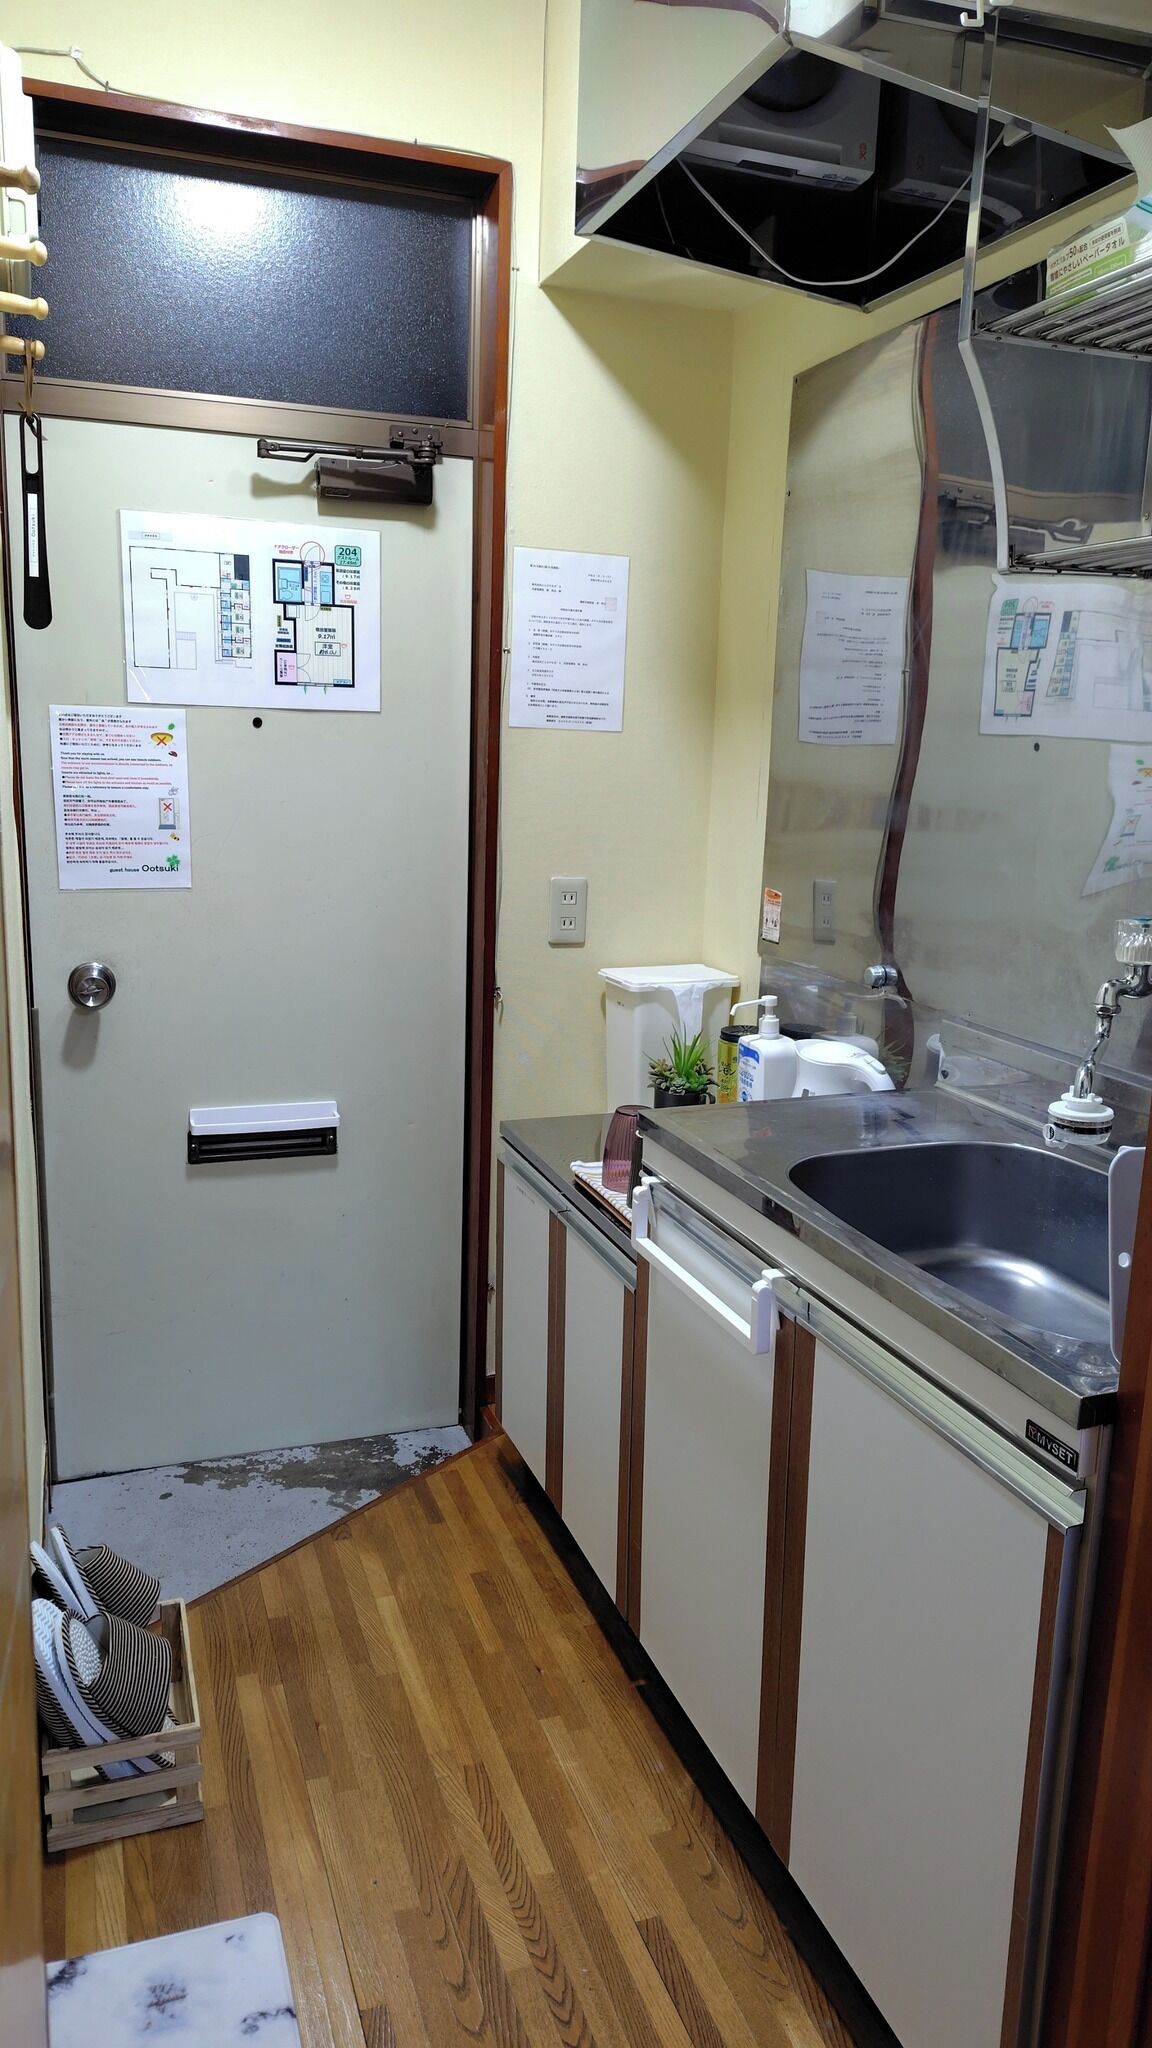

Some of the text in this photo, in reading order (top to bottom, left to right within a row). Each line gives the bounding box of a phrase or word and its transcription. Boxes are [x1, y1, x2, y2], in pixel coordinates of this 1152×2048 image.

[338, 547, 358, 557] 204
[142, 863, 179, 873] Ootsuki
[1037, 1432, 1073, 1465] MYSET
